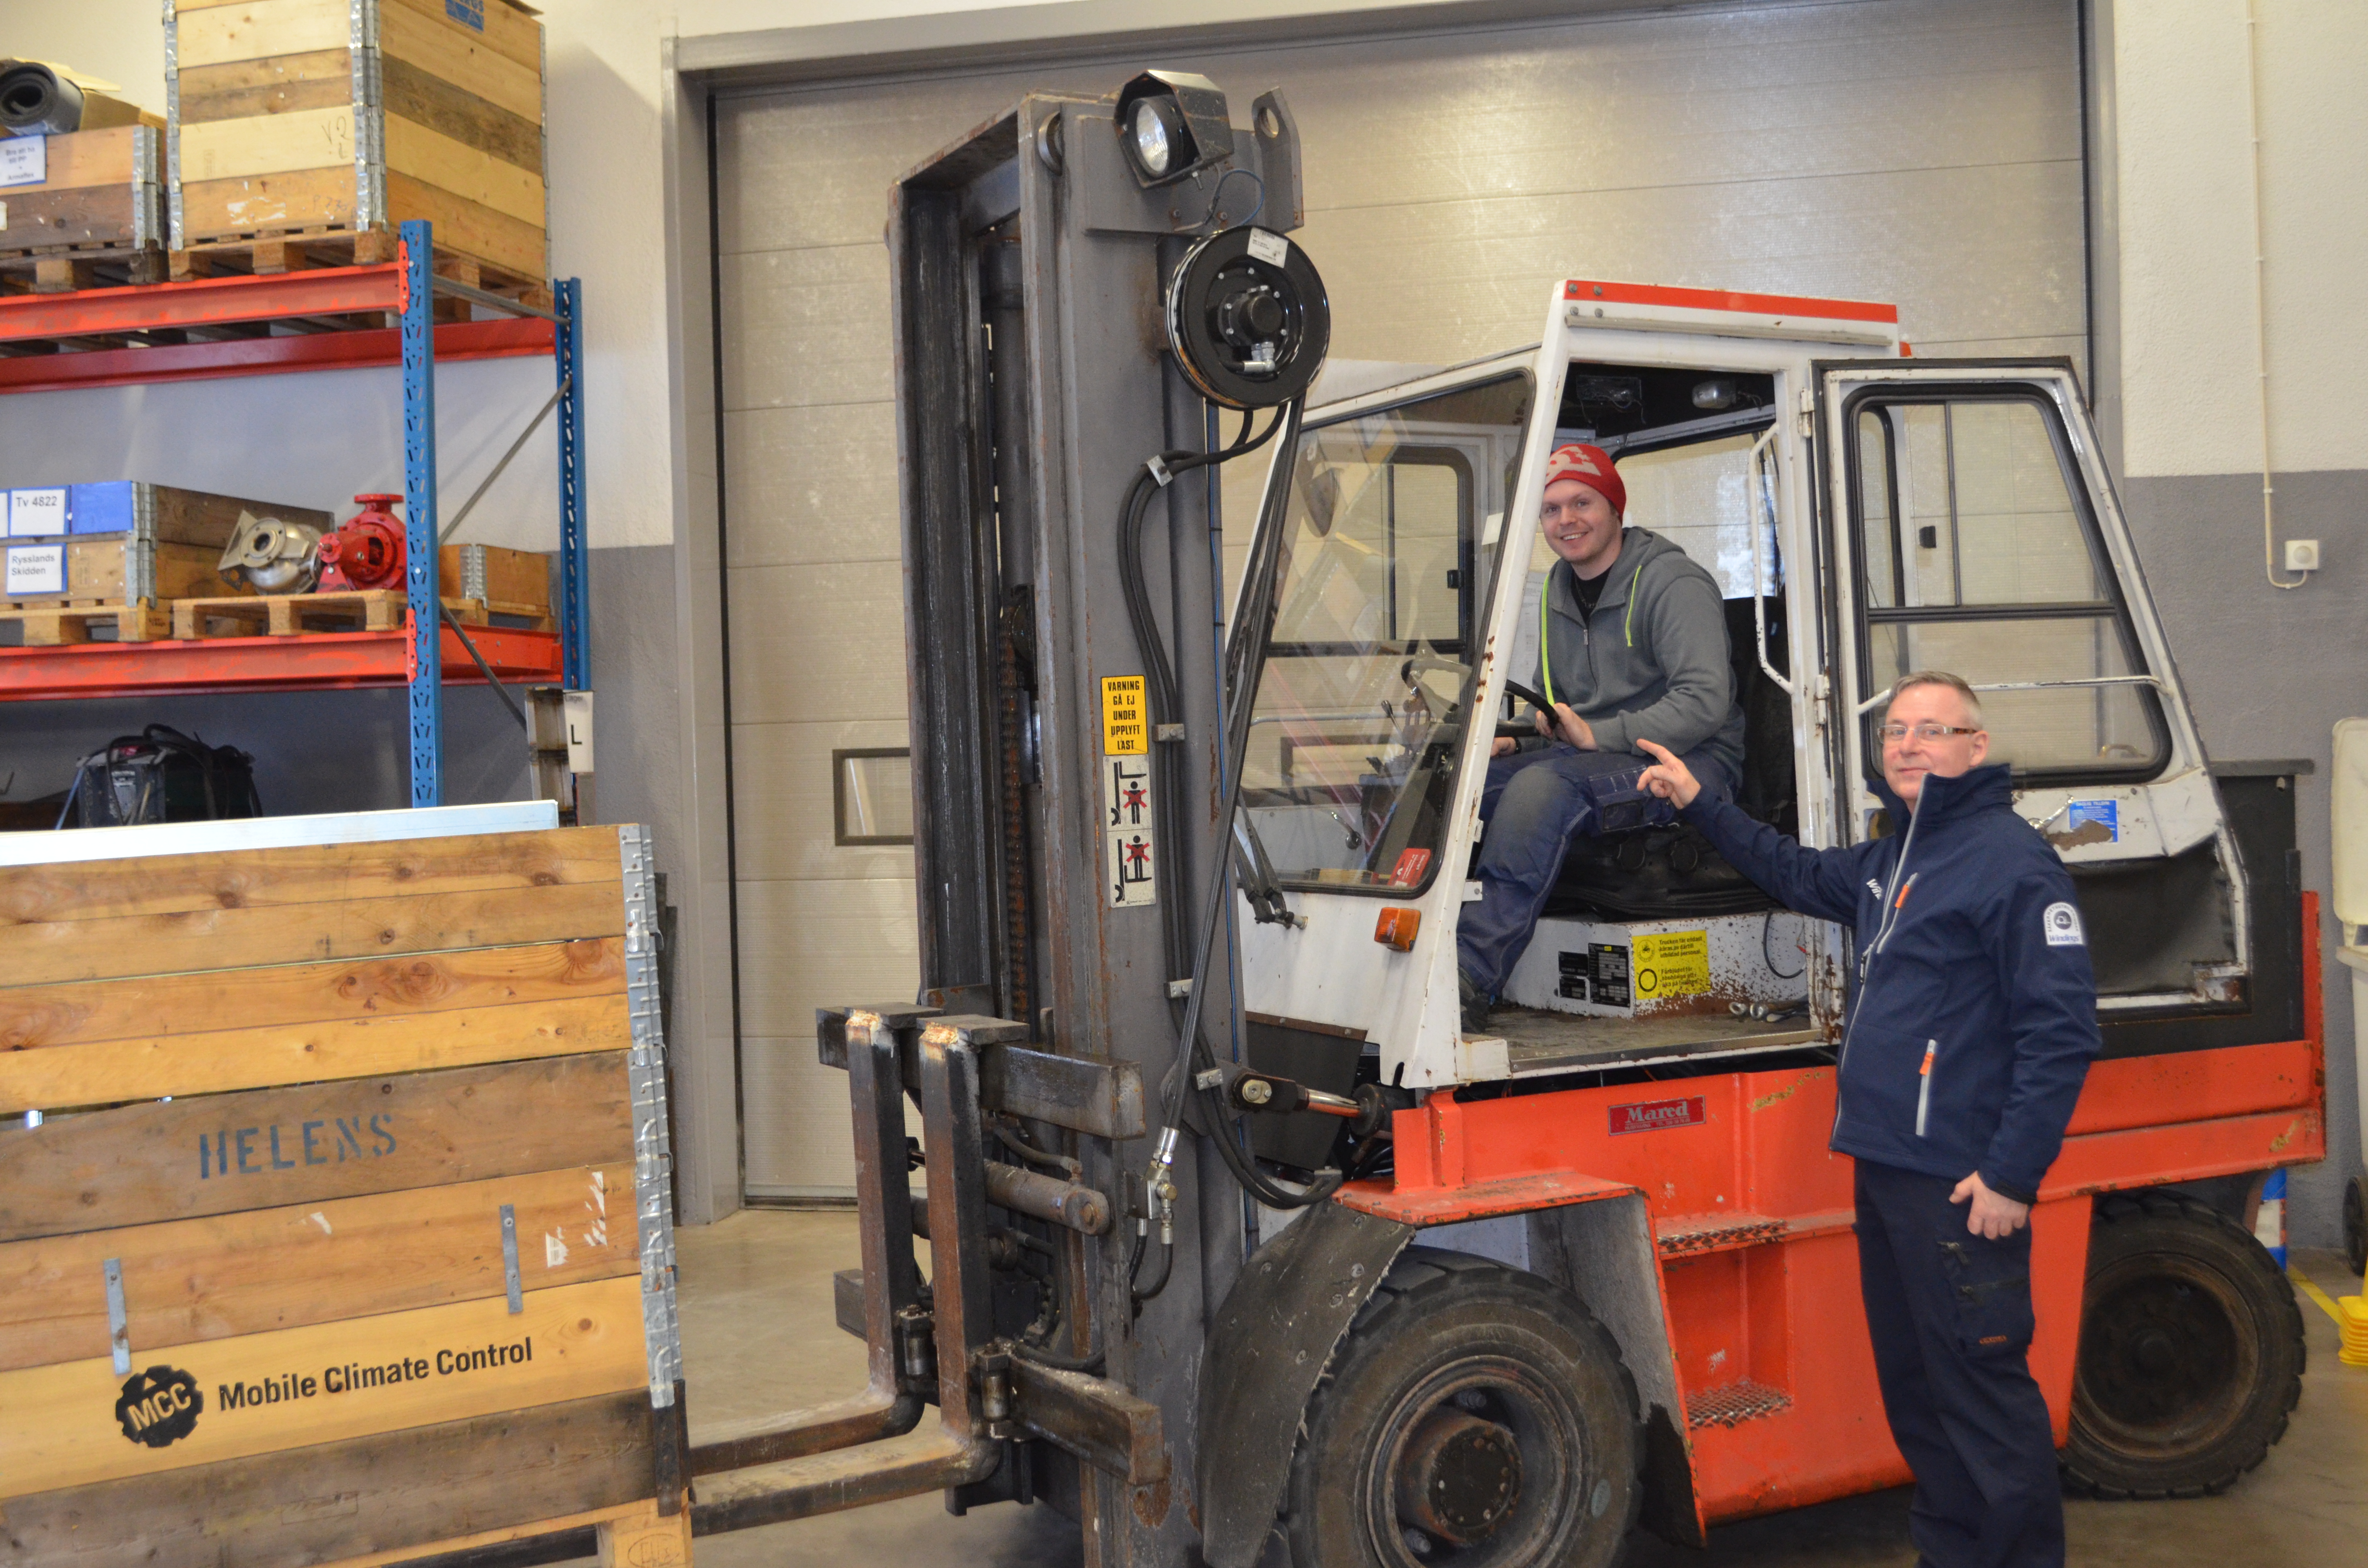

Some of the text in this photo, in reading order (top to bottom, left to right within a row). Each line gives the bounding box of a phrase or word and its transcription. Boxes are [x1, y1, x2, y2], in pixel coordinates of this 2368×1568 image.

[16, 496, 57, 507] Tv 4822
[12, 554, 55, 565] Rysslands
[12, 567, 46, 576] Skidden
[1108, 681, 1140, 691] VARNING
[1113, 694, 1135, 705] GÅ EJ
[1113, 710, 1136, 720] UNDER
[571, 724, 582, 745] L
[1110, 725, 1140, 735] UPPLYFT
[1117, 740, 1134, 750] LAST
[1625, 1101, 1690, 1123] Mared
[199, 1114, 396, 1179] HELENS
[219, 1336, 532, 1411] Mobile Climate Control
[127, 1382, 192, 1431] MCC
